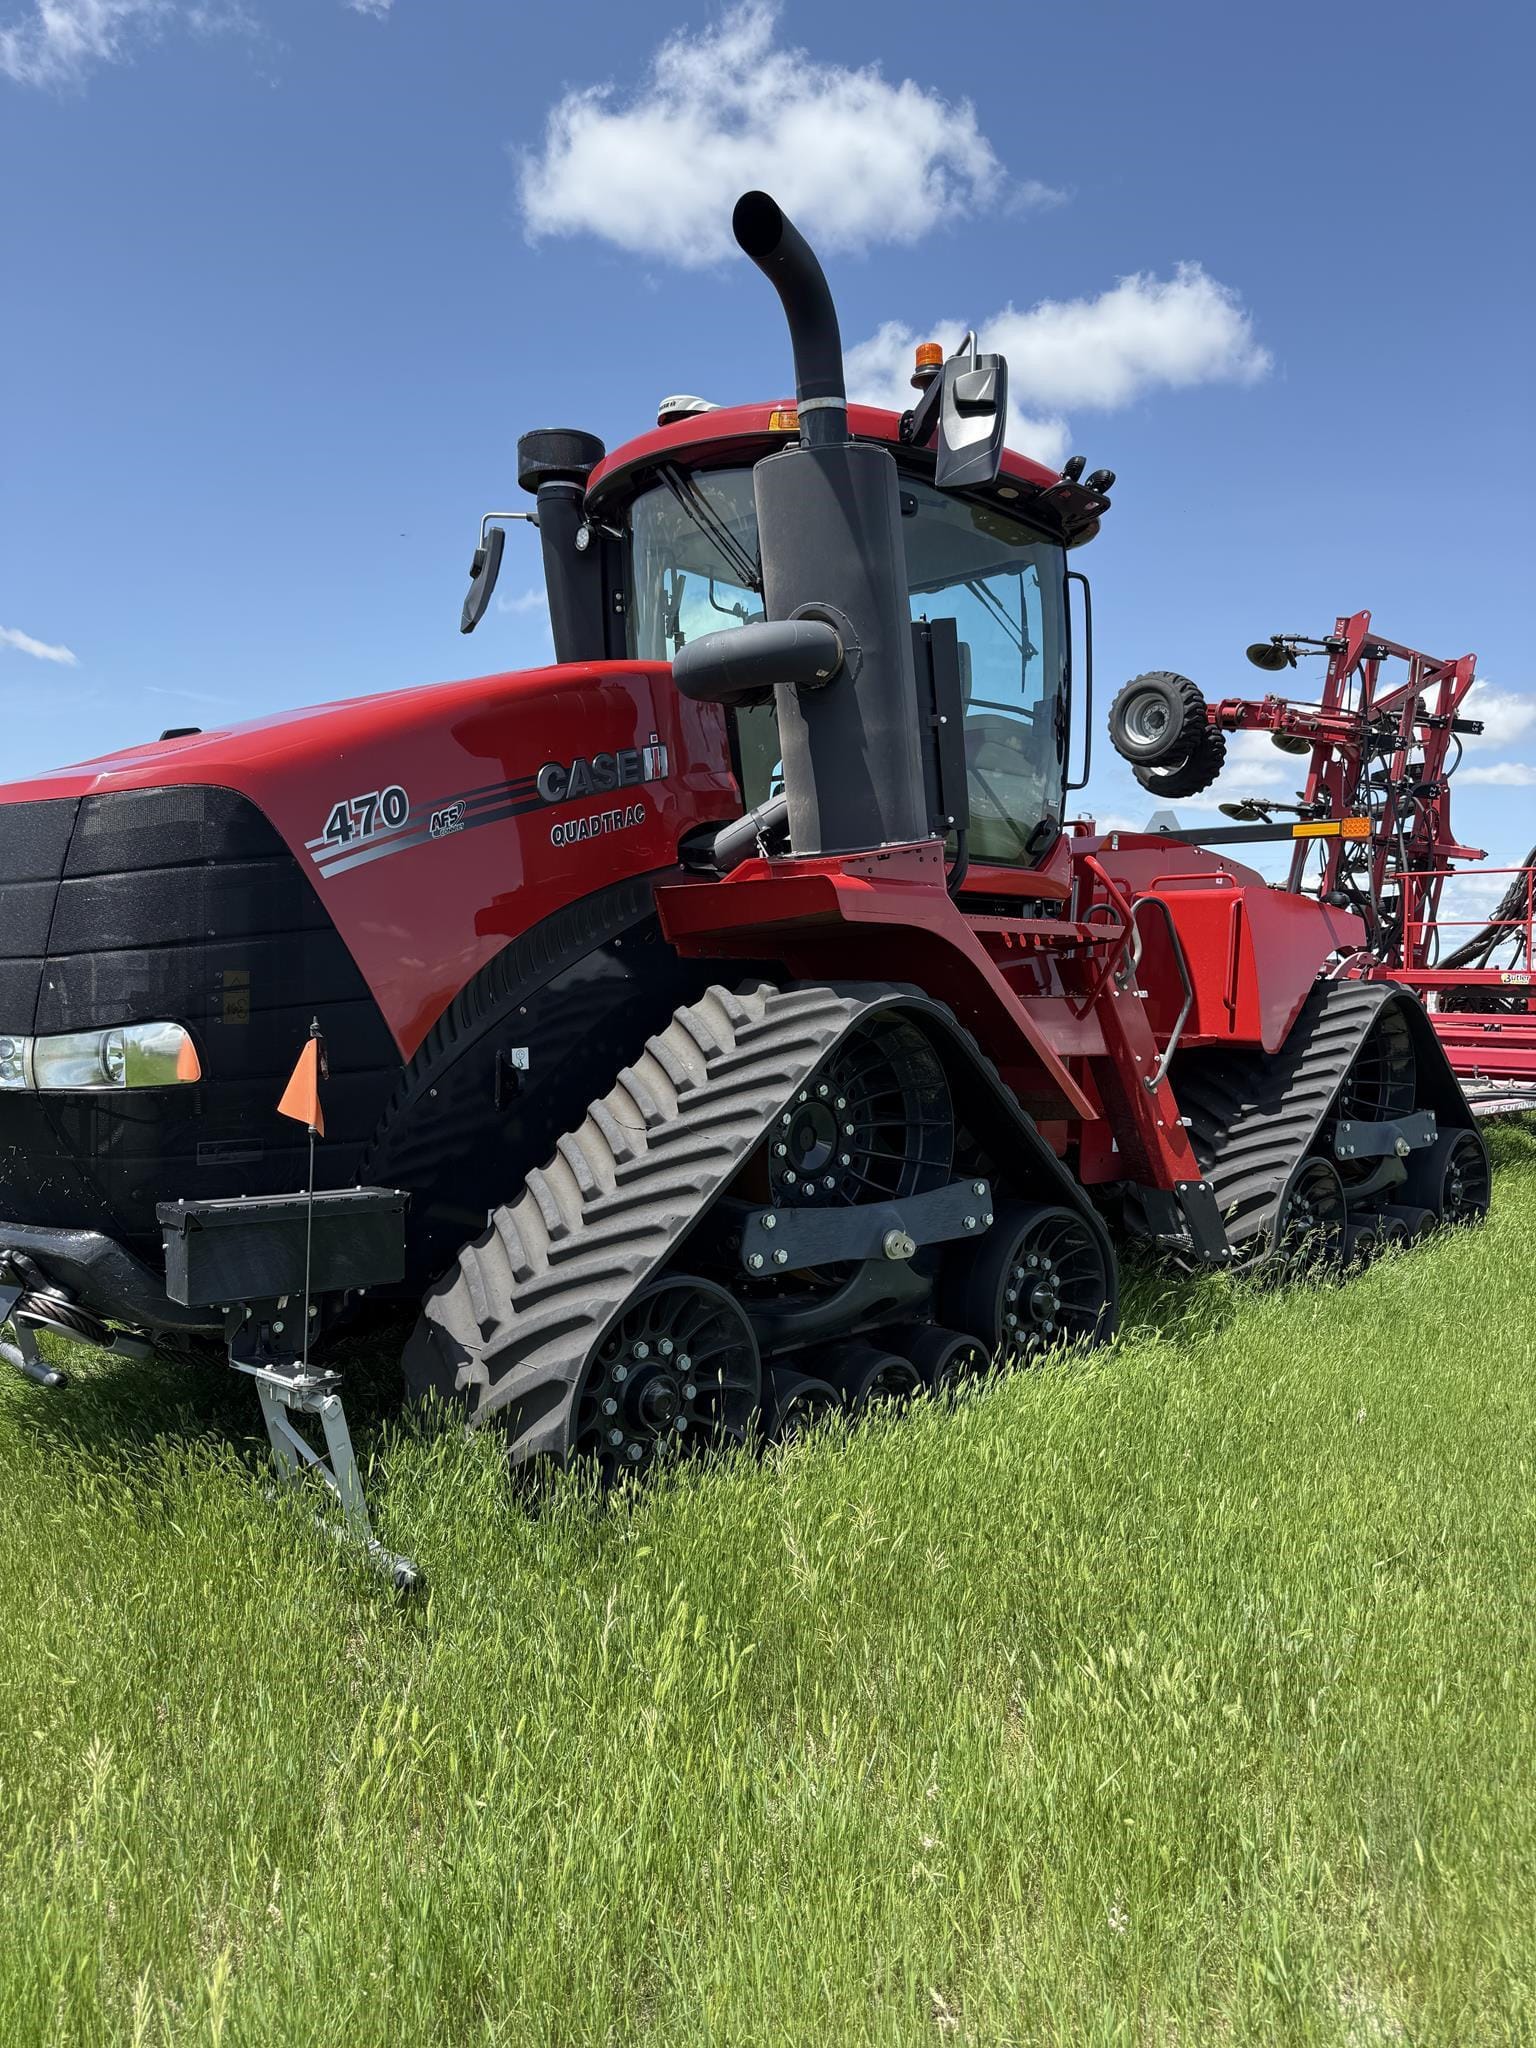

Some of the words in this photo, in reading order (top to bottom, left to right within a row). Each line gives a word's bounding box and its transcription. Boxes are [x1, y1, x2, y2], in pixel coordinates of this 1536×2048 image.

[1394, 736, 1403, 748] 26
[536, 749, 643, 801] CASE
[323, 784, 409, 847] 470
[430, 805, 459, 832] AFS
[551, 804, 646, 848] QUADTRAC
[1503, 974, 1529, 983] Butler
